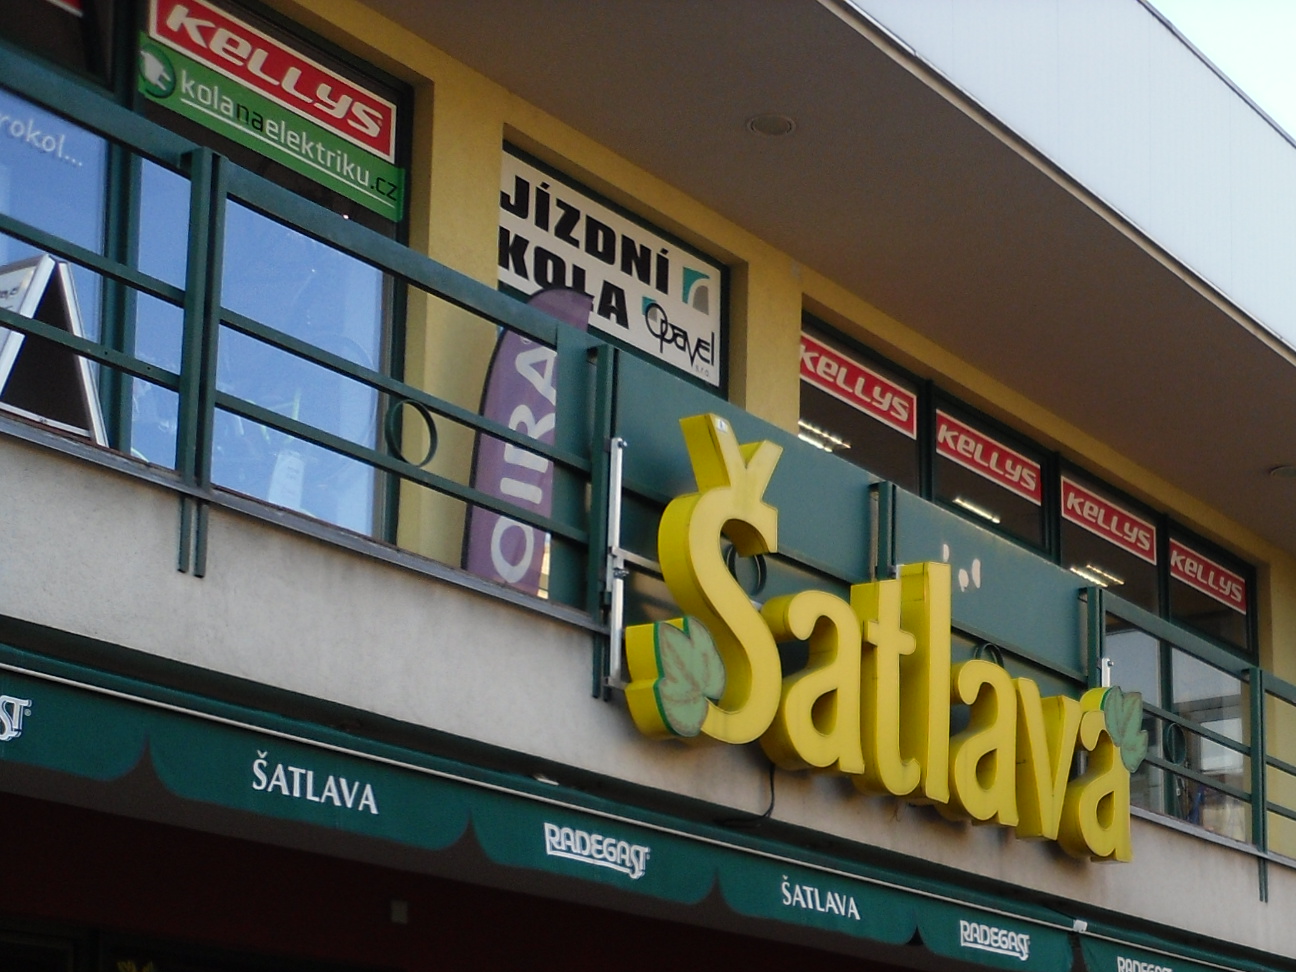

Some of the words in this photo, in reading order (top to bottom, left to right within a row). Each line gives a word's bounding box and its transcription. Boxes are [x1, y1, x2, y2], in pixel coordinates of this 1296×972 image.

[180, 69, 398, 201] kolanaelektriku.cz
[500, 174, 670, 296] JÍZDNÍ
[656, 411, 1134, 863] Šatlava
[252, 750, 380, 815] ŠATLAVA
[544, 822, 650, 880] RADEGAST
[781, 874, 861, 921] ŠATLAVA
[959, 920, 1031, 962] RADEGAST
